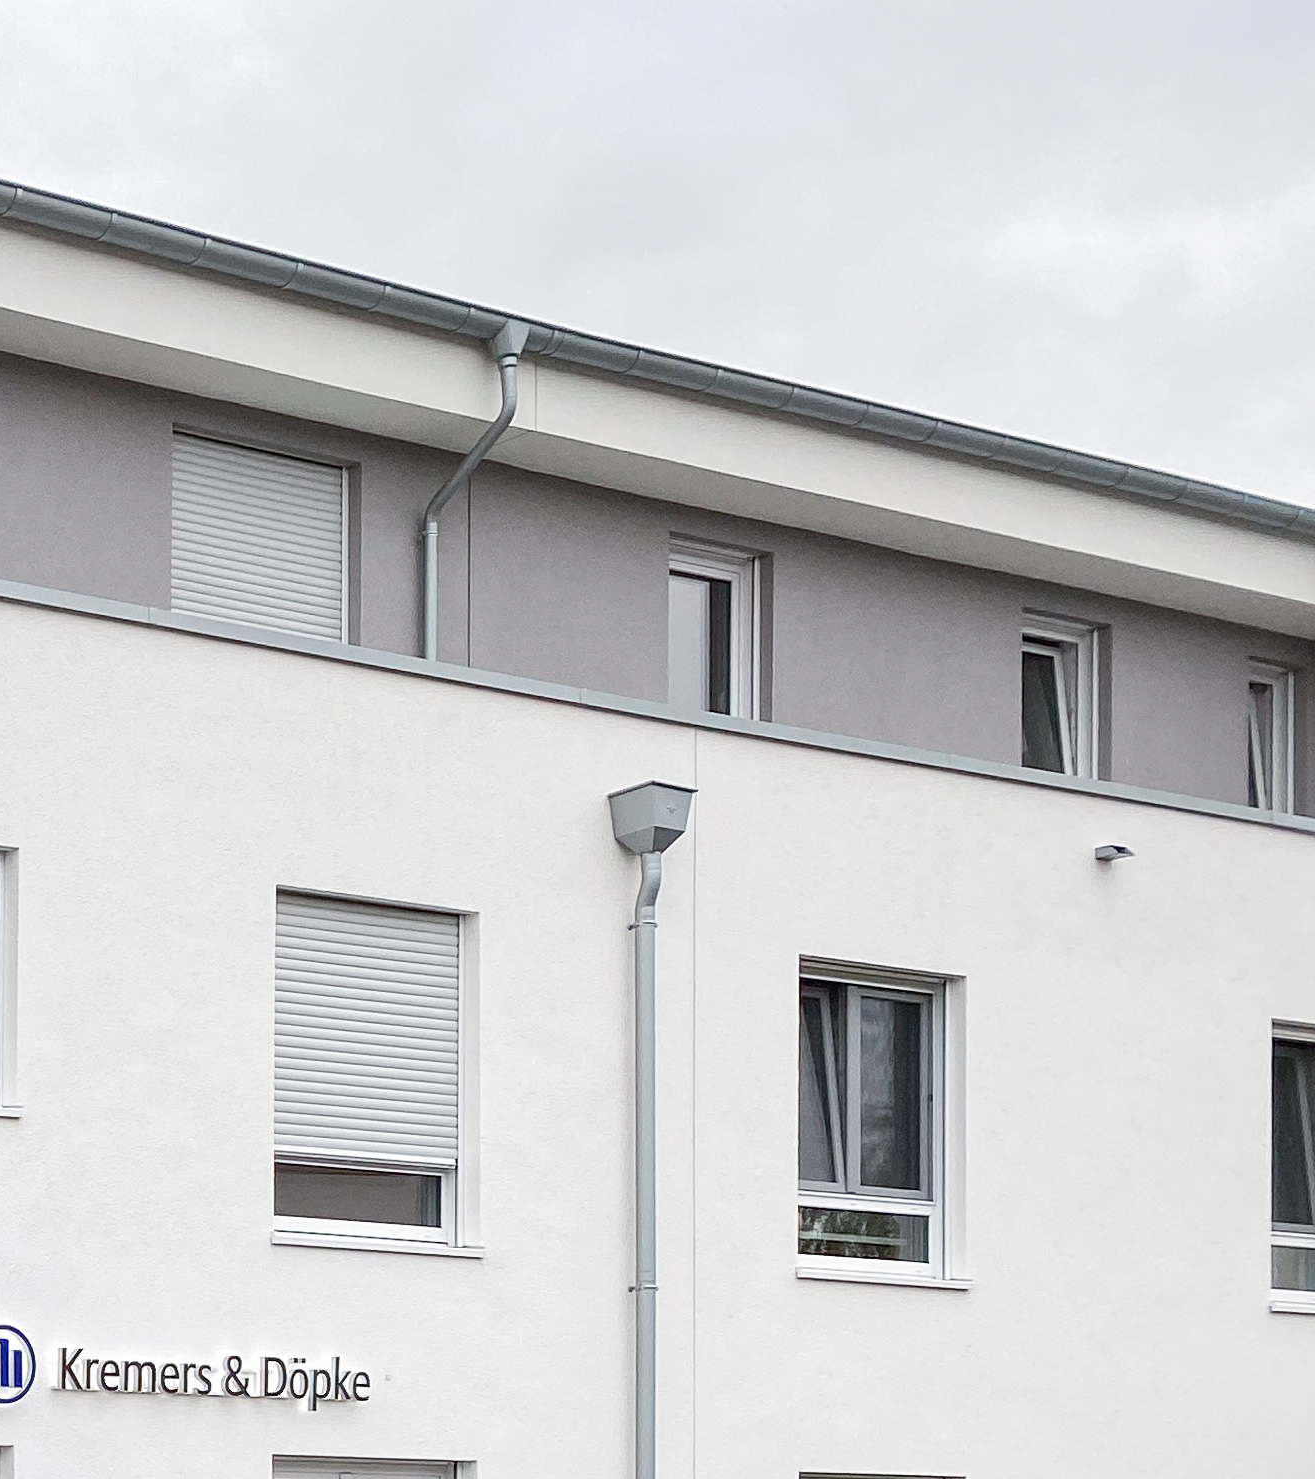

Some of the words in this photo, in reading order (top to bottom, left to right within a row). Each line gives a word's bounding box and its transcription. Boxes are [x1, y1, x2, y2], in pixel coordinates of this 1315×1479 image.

[60, 1347, 212, 1396] Kremers
[224, 1354, 252, 1398] &
[261, 1355, 371, 1412] Döpke
